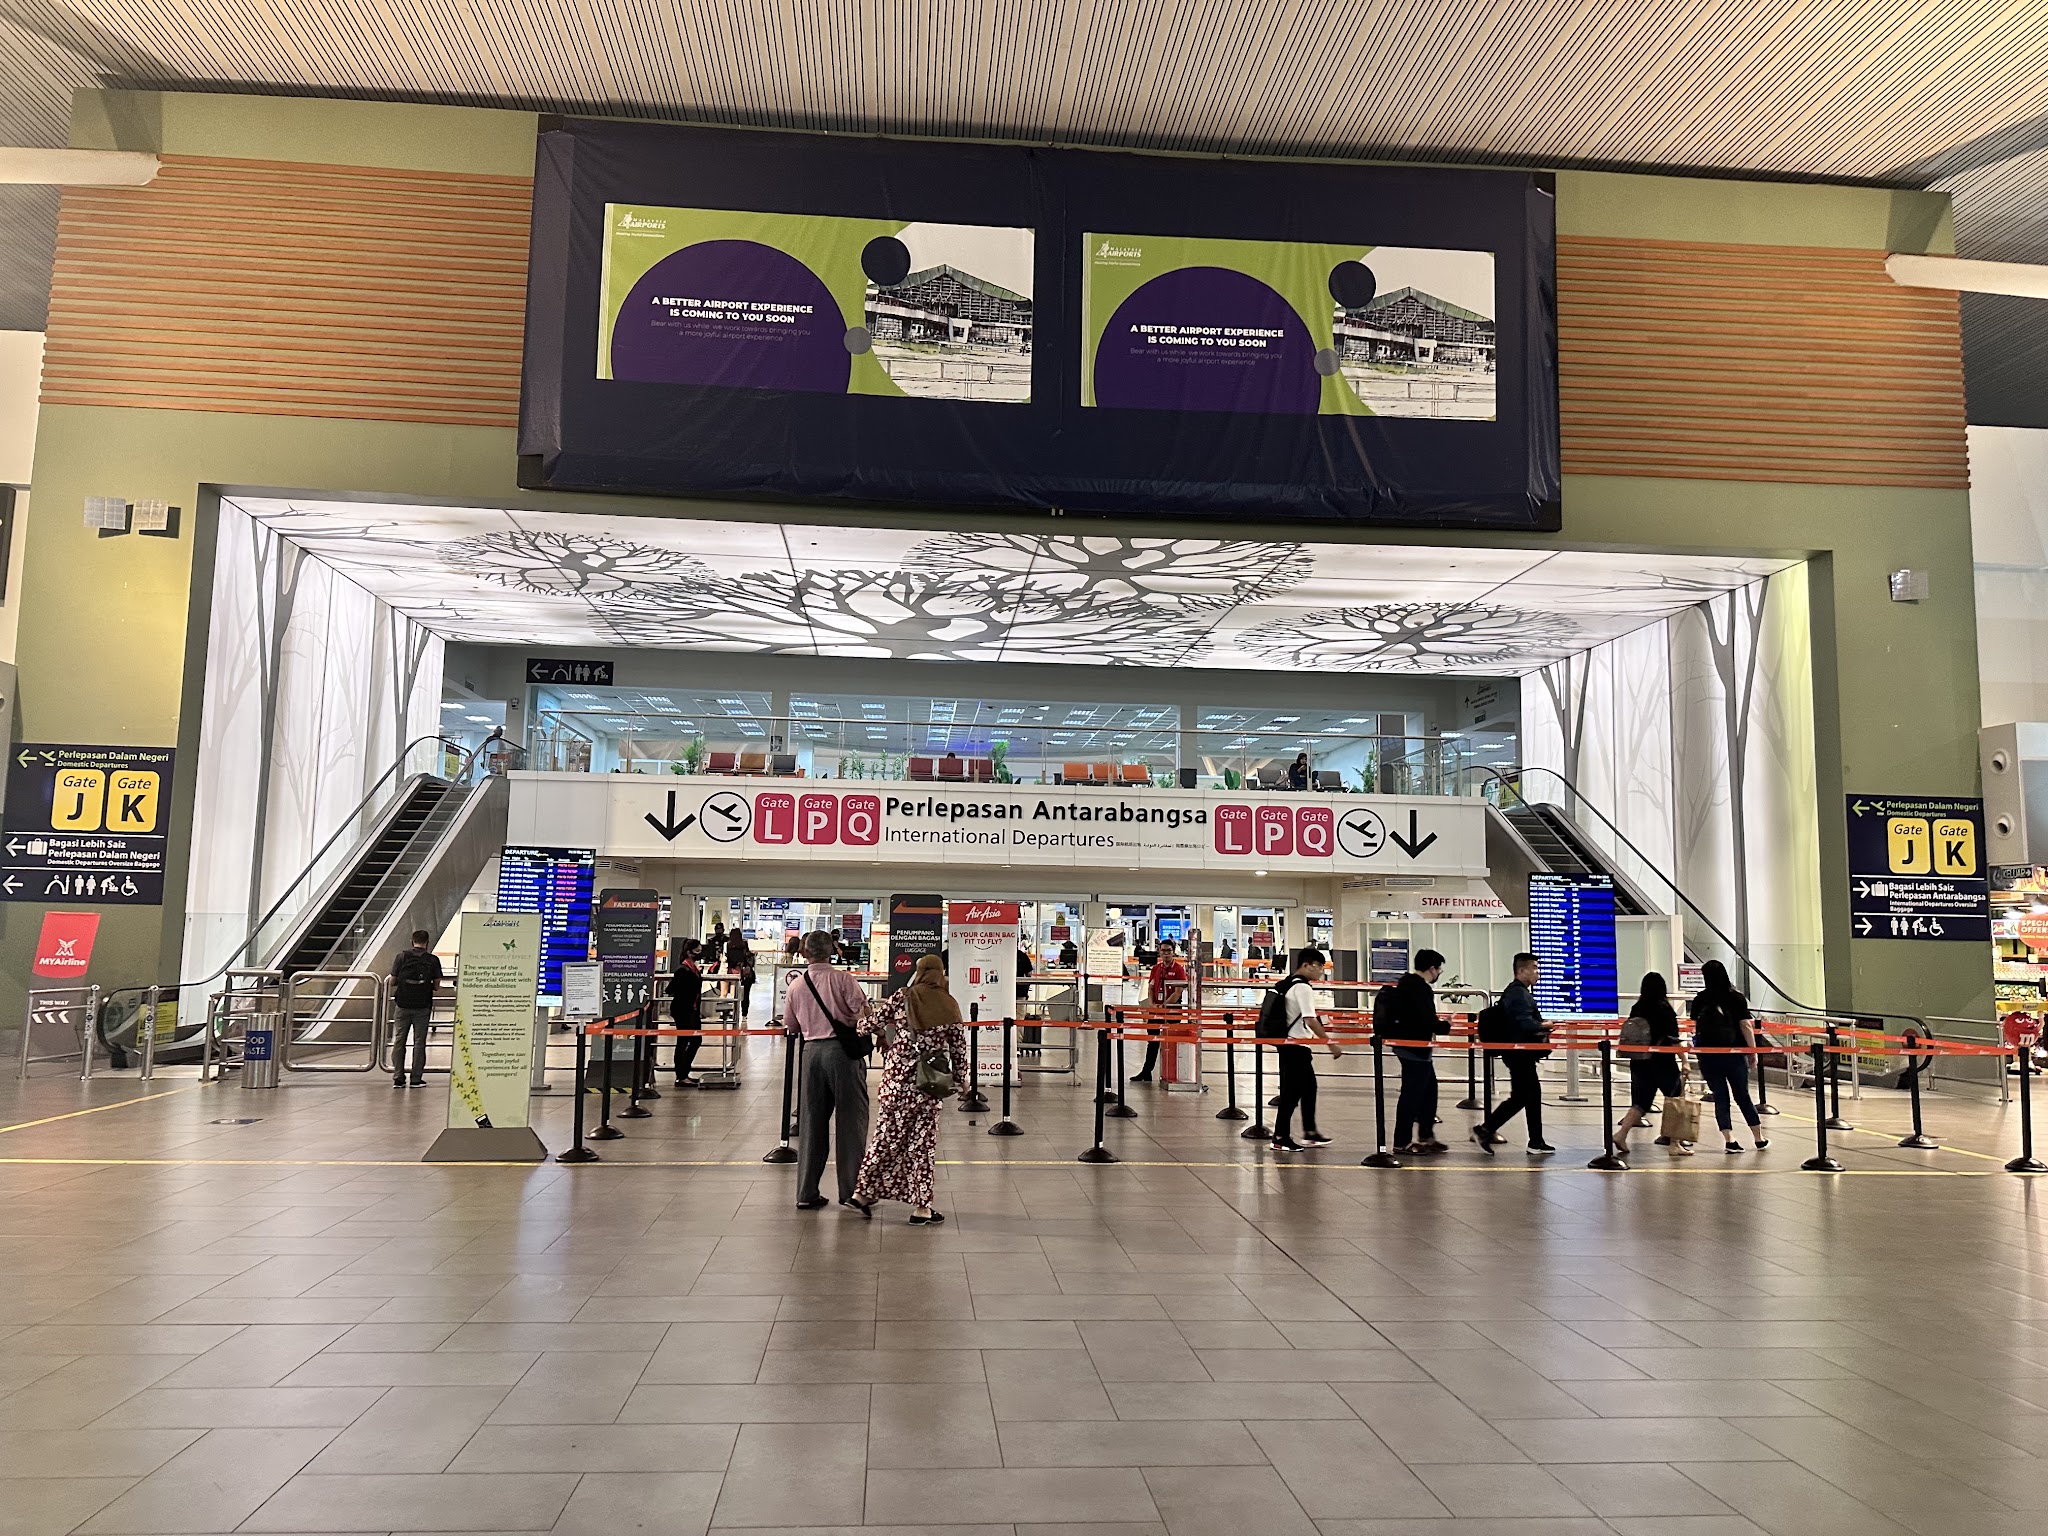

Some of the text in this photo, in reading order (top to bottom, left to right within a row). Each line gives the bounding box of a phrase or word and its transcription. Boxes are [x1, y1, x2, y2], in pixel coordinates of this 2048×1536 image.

[630, 222, 666, 230] AIRPORTS
[1108, 250, 1142, 258] AIRPORTS
[652, 296, 814, 314] A BETTER AIRPORT EXPERIENCE
[670, 308, 795, 324] IS COMING TO YOU SOON
[650, 320, 666, 328] Bear
[668, 320, 683, 328] with
[692, 322, 710, 330] while
[724, 324, 740, 332] work
[742, 325, 768, 334] towards
[769, 326, 797, 336] bringing
[798, 328, 811, 336] you
[1130, 324, 1284, 338] A BETTER AIRPORT EXPERIENCE
[703, 330, 720, 339] joyful
[722, 332, 745, 341] airport
[746, 333, 783, 342] experience
[1148, 336, 1267, 348] IS COMING TO YOU SOON
[1199, 350, 1215, 358] work
[1216, 350, 1241, 359] towards
[1242, 352, 1270, 360] bringing
[1180, 356, 1196, 365] joyful
[1198, 358, 1220, 366] airport
[1221, 358, 1256, 367] experience
[58, 750, 169, 763] Perlepasan Dalam Negeri
[63, 776, 152, 790] Gate Gate
[66, 792, 146, 822] J K
[761, 797, 875, 810] Gate Gate Gate
[1886, 800, 1978, 812] Perlepasan Dalam Negeri
[886, 796, 1208, 828] Perlepasan Antarabangsa
[1220, 808, 1329, 822] Gate Gate Gate
[1914, 810, 1946, 818] Departures
[764, 810, 871, 842] L P Q
[1894, 824, 1968, 836] Gate Gate
[49, 838, 126, 849] Bagasi Lebih Saiz
[885, 826, 1005, 844] International
[1012, 830, 1114, 849] Departures
[1224, 822, 1326, 853] L P Q
[48, 849, 160, 862] Perlepasan Dalam Negeri
[1902, 840, 1967, 867] J K
[47, 858, 74, 866] Domestic
[1888, 882, 1954, 892] Bagasi Lebih Saiz
[1890, 891, 1986, 902] Perlepasan Antarabangsa
[1422, 898, 1503, 908] STAFF ENTRANCE
[38, 957, 86, 966] MYAirline
